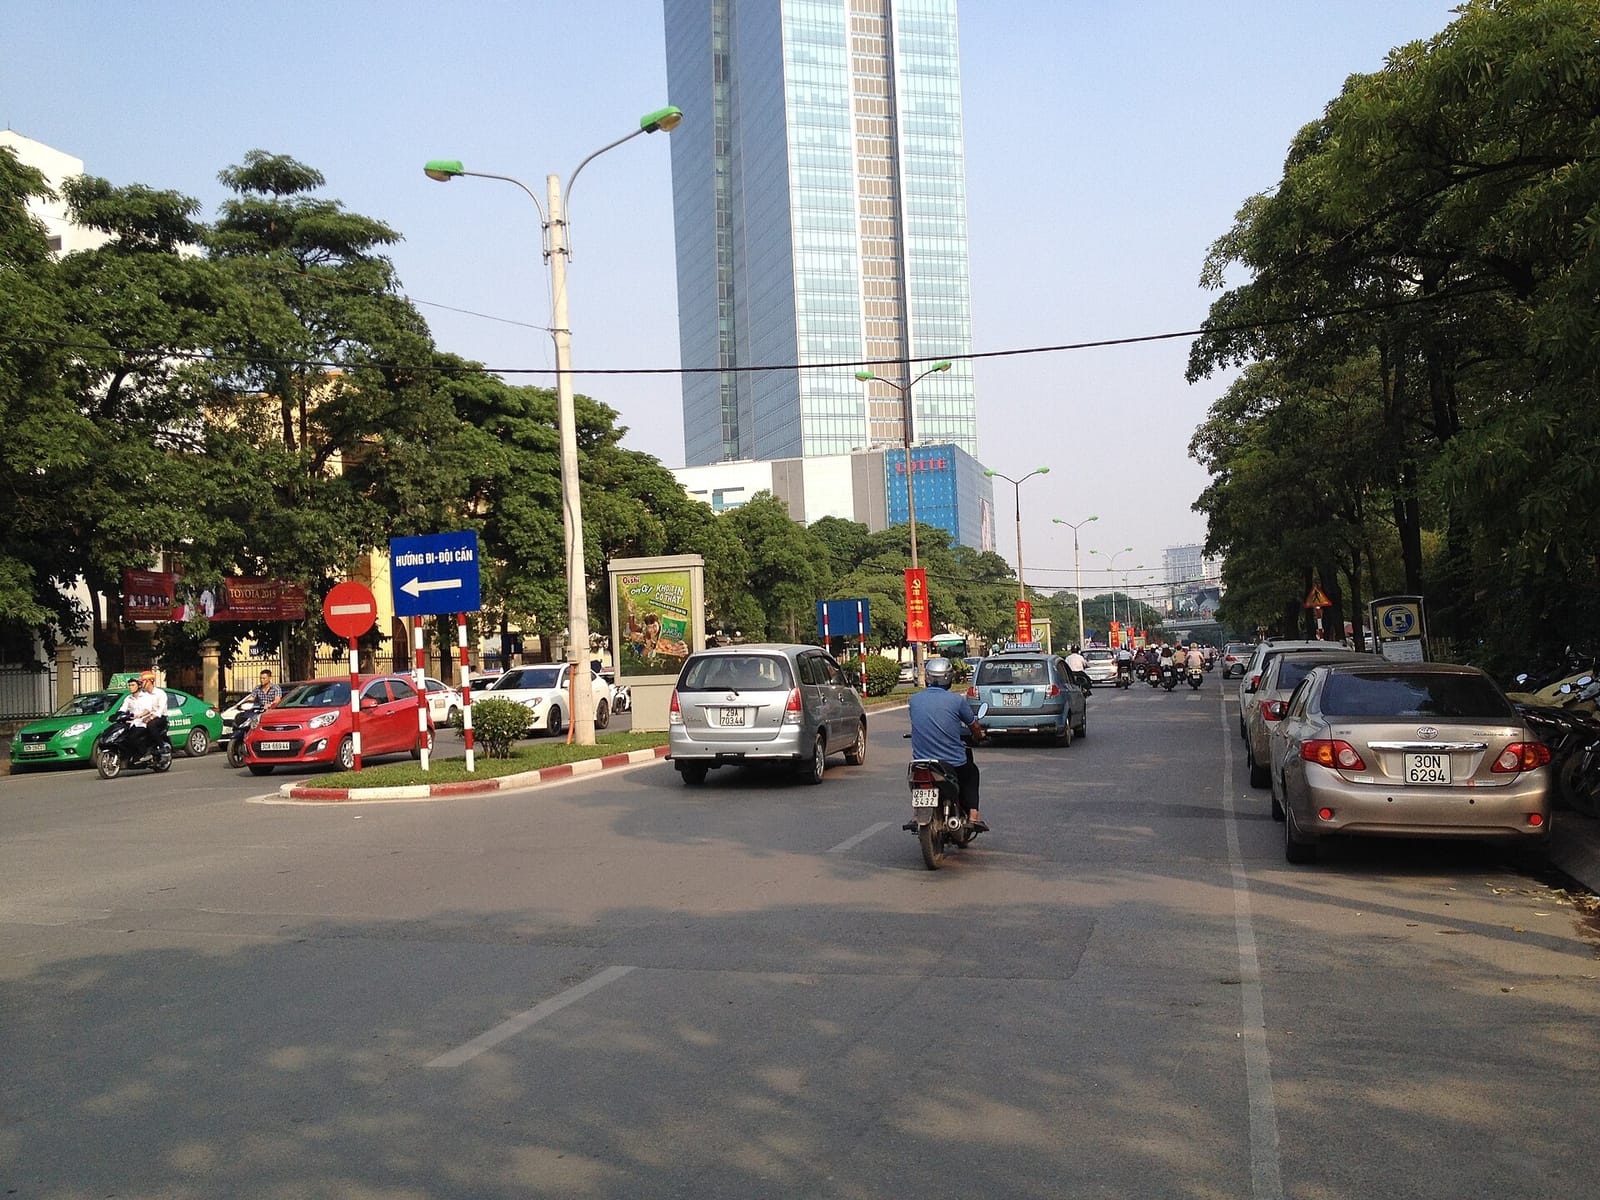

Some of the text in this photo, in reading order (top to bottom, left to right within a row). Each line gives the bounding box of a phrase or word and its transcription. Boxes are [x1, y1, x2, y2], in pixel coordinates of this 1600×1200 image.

[229, 588, 259, 598] TOYOTA
[1414, 755, 1441, 768] 30N
[1410, 769, 1446, 782] 6294
